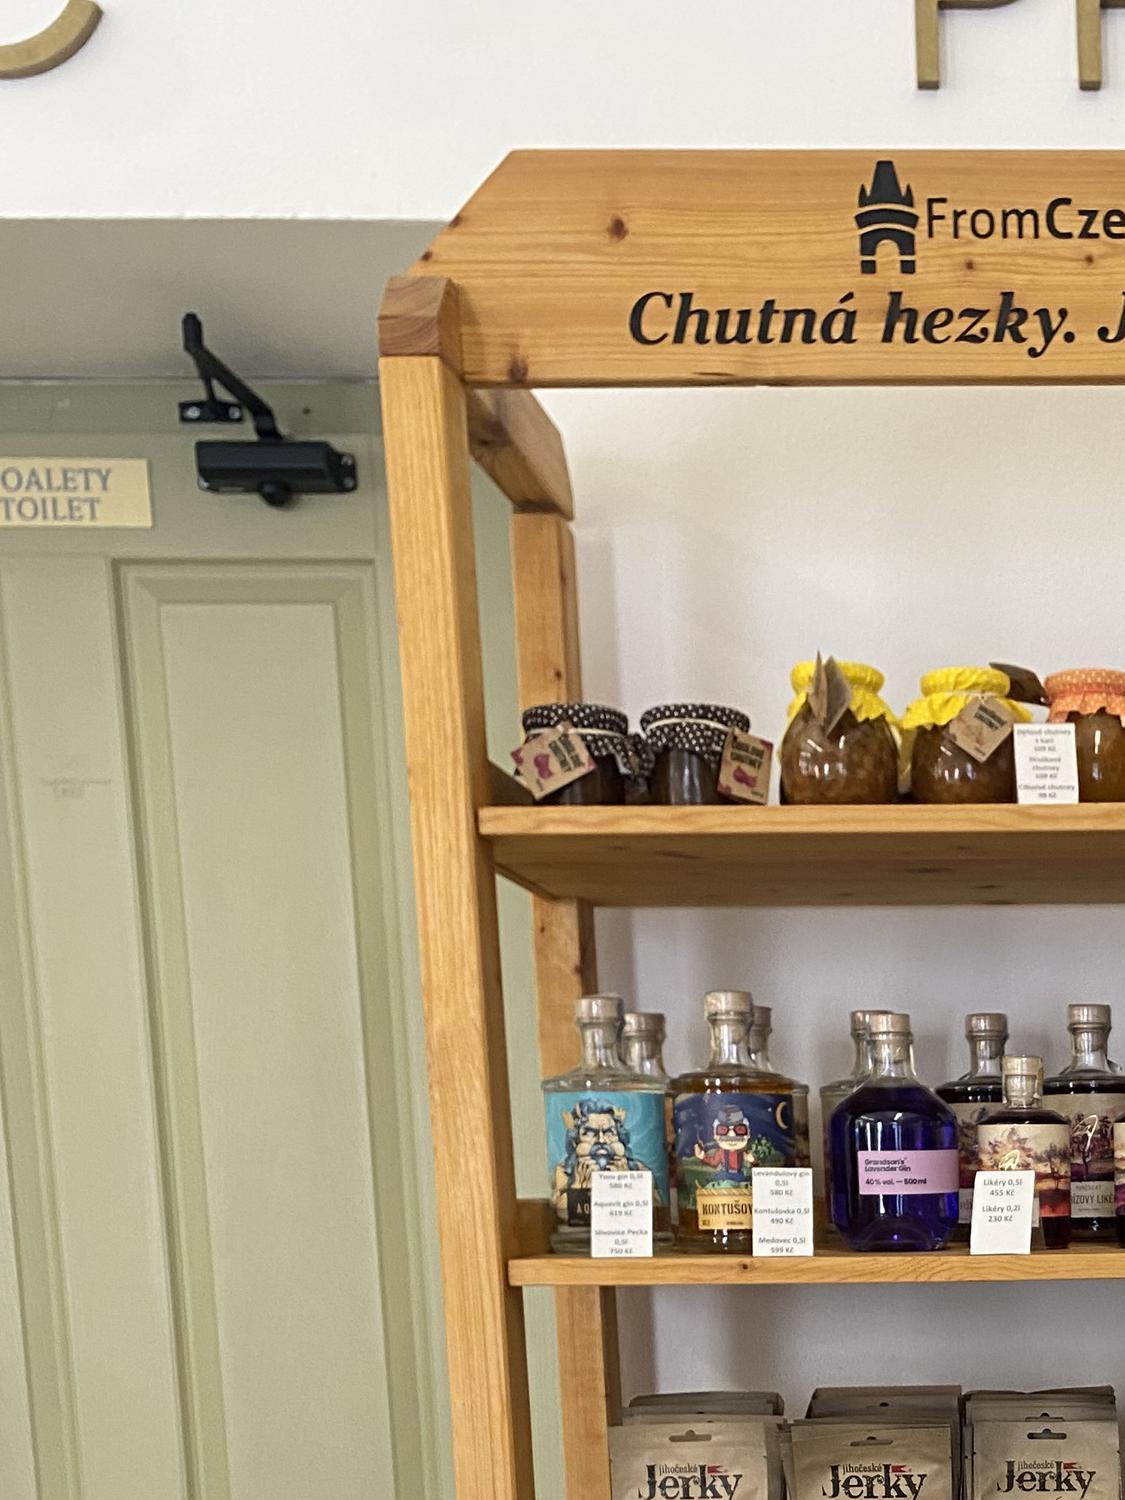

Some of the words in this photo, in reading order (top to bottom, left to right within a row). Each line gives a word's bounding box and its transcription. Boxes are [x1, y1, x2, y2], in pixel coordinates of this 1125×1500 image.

[630, 291, 858, 346] Chutná
[881, 291, 1075, 358] hezky.
[983, 1178, 1006, 1187] Likéry
[982, 1205, 1005, 1213] Likéry
[988, 1215, 1002, 1223] 230
[759, 1236, 791, 1244] Medovec
